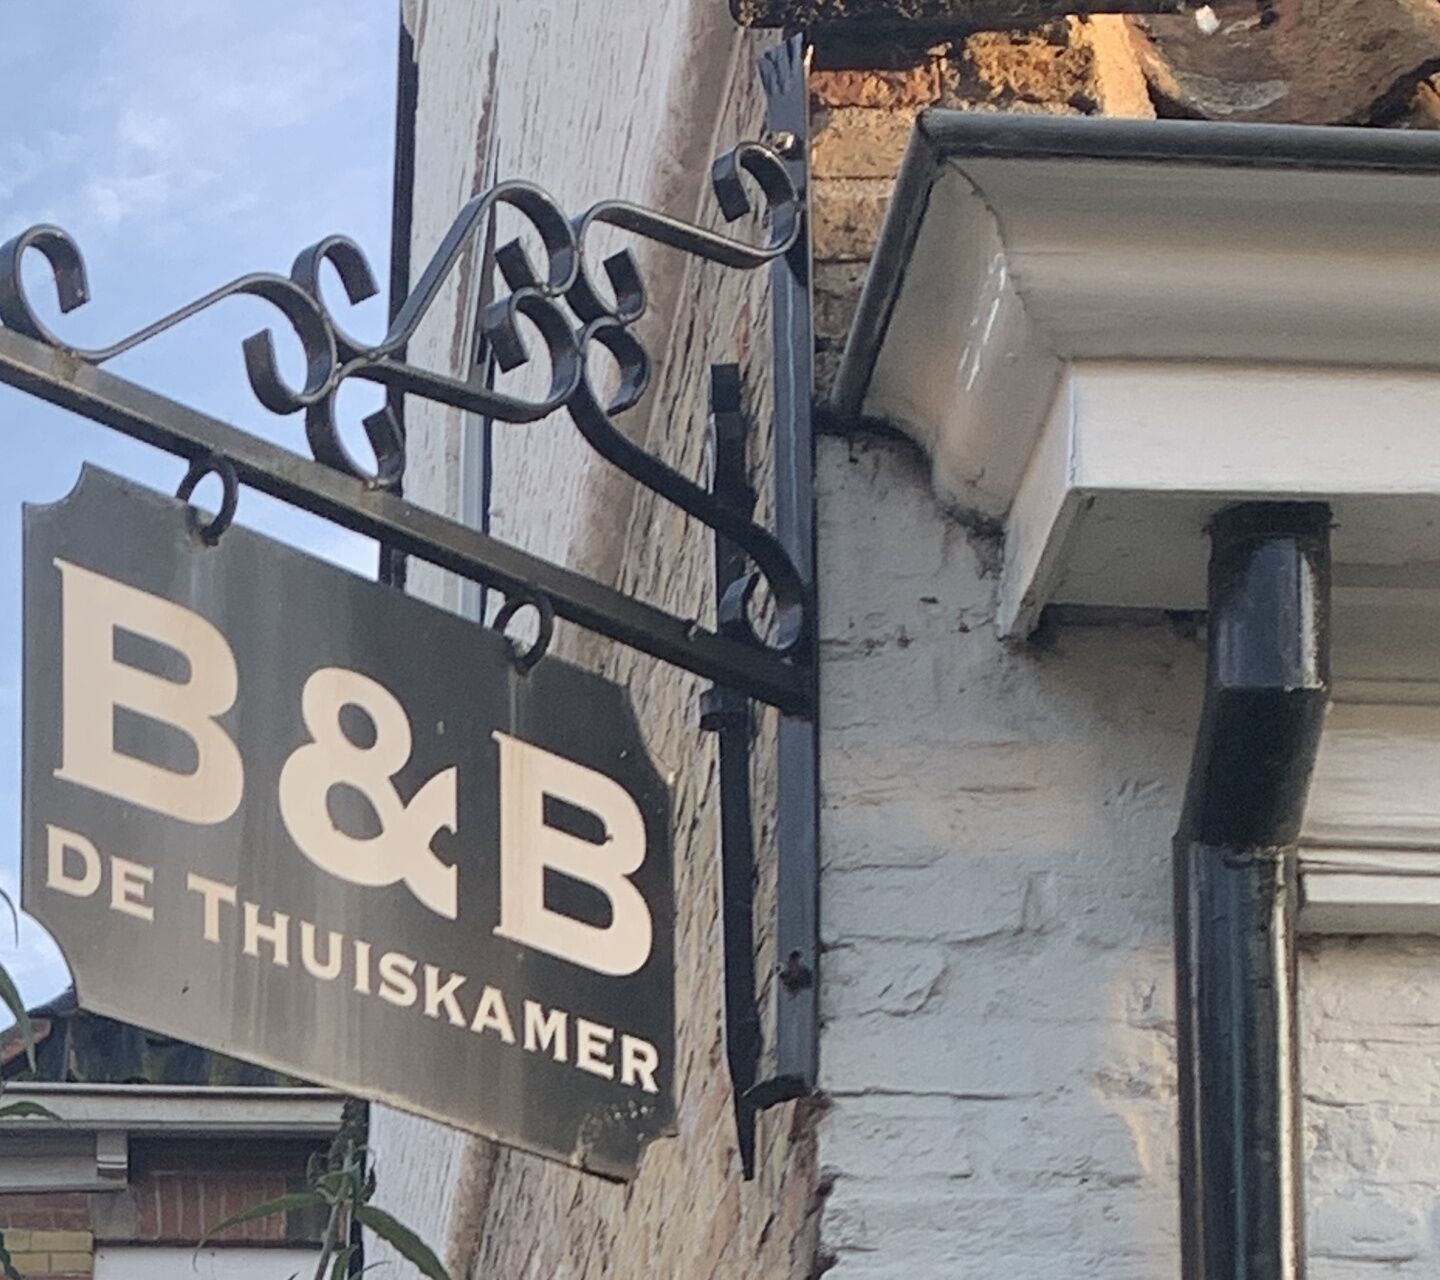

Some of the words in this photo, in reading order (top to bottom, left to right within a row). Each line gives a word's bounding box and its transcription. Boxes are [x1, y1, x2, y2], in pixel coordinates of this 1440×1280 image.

[53, 557, 654, 977] B&B
[45, 824, 155, 921] DE
[187, 872, 660, 1094] THUISKAMER
